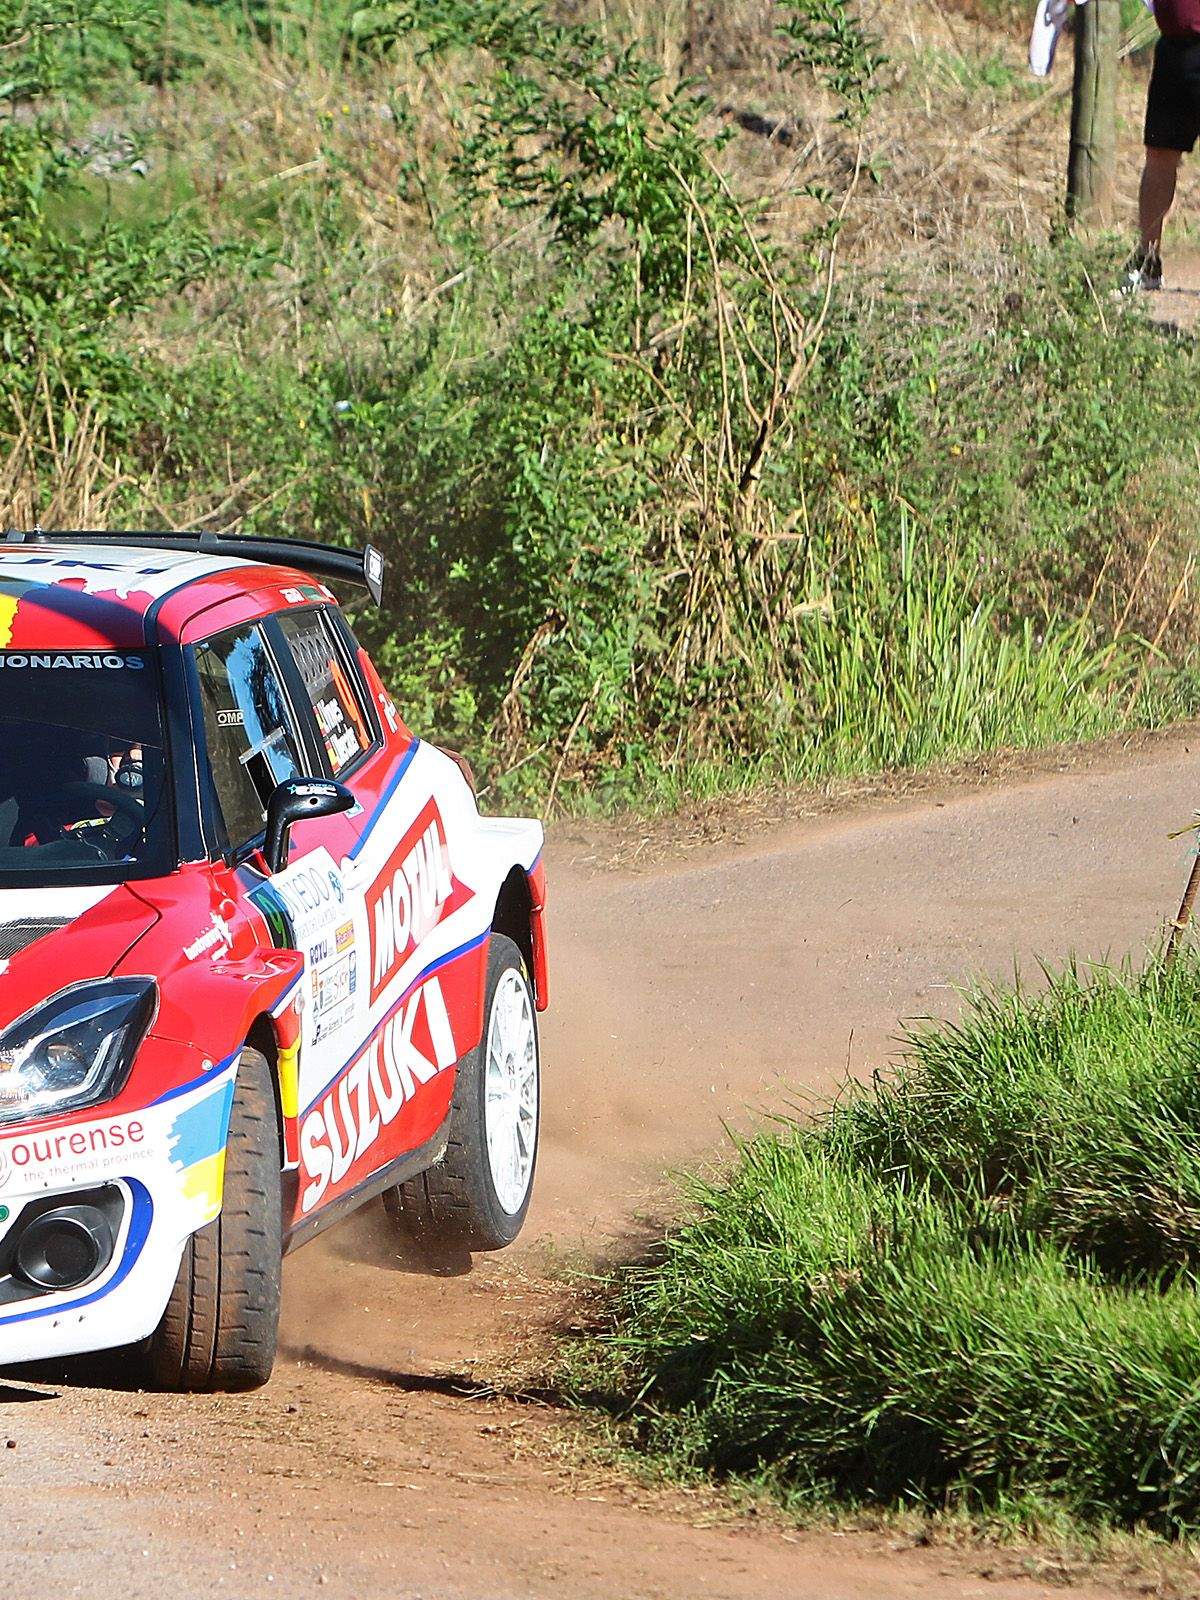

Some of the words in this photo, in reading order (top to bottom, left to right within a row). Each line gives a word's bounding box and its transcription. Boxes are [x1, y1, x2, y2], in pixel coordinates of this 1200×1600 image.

[218, 712, 243, 724] OMP
[373, 819, 453, 985] MOTUL
[300, 975, 458, 1214] SUZUKI
[11, 1121, 145, 1166] ourense
[24, 1170, 45, 1182] the
[49, 1158, 100, 1177] thermal
[103, 1148, 155, 1168] province
